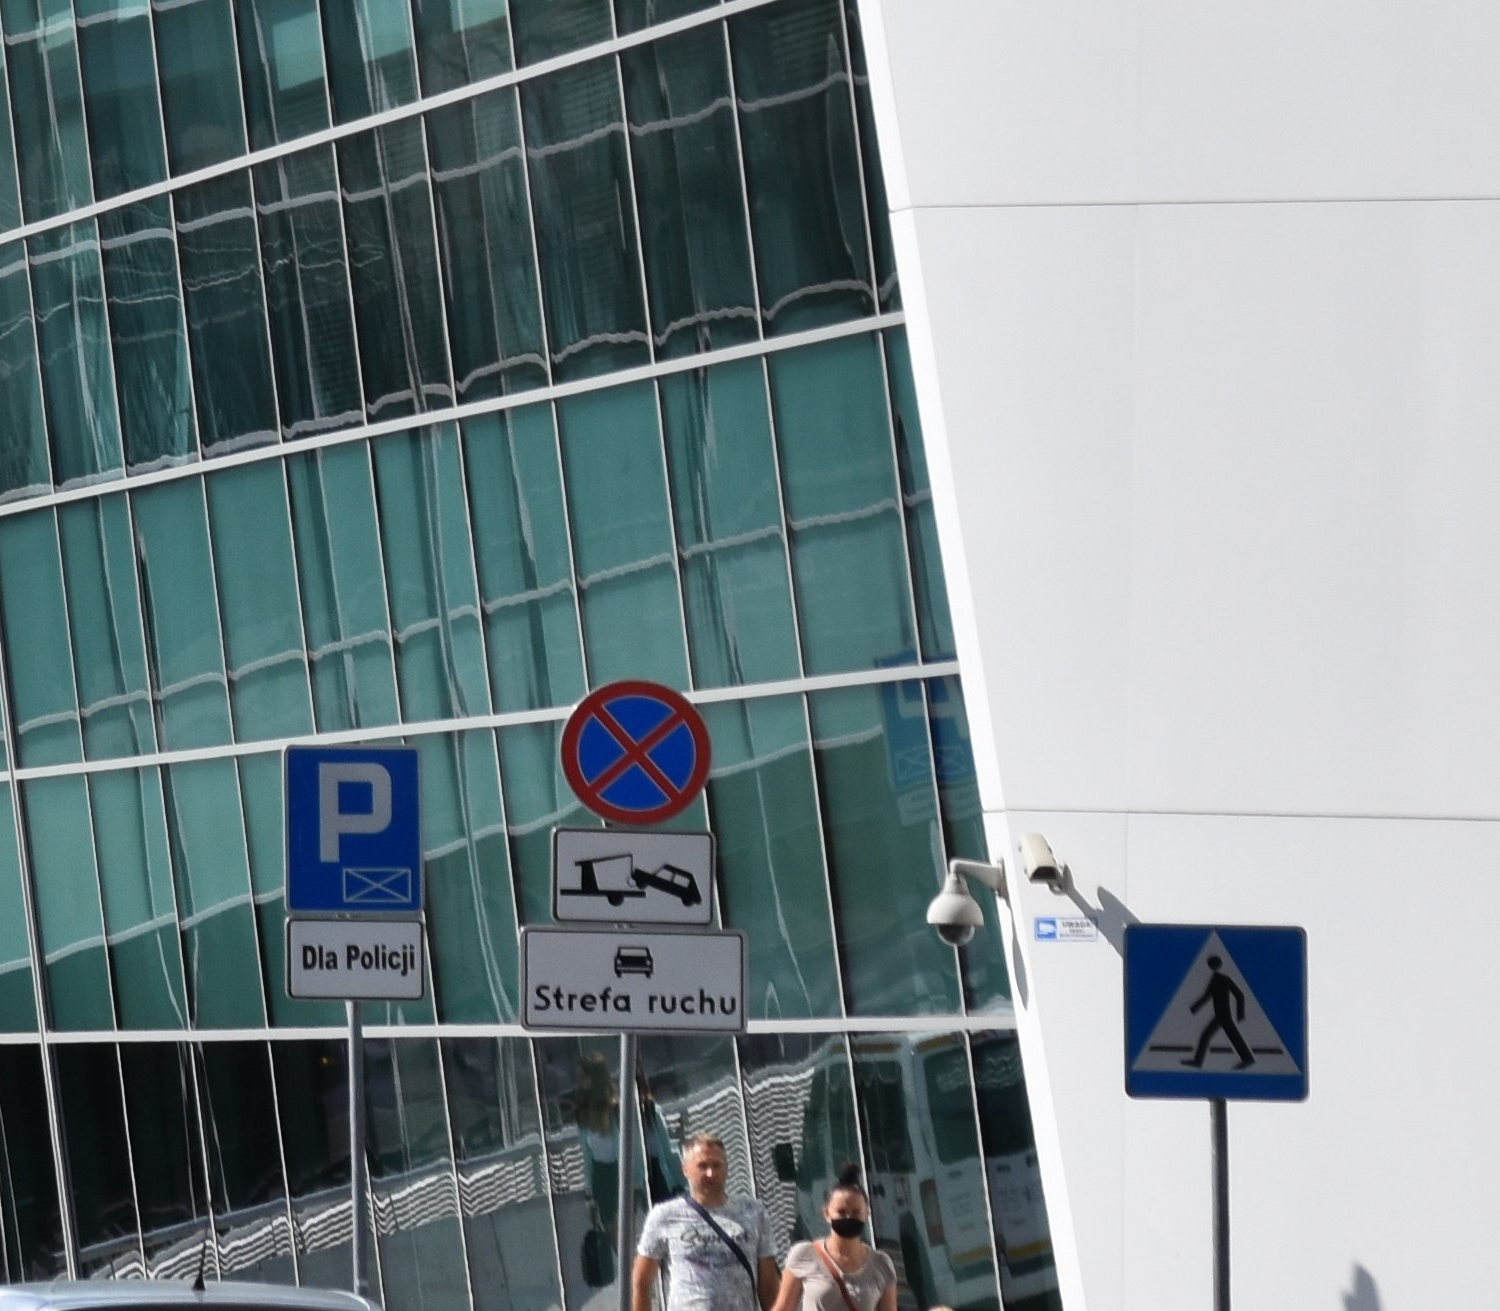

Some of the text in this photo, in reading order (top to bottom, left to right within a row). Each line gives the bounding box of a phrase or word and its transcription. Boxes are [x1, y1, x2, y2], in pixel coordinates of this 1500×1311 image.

[319, 762, 392, 863] P
[302, 945, 416, 977] Dla Policji
[534, 986, 737, 1016] Strefa ruchu
